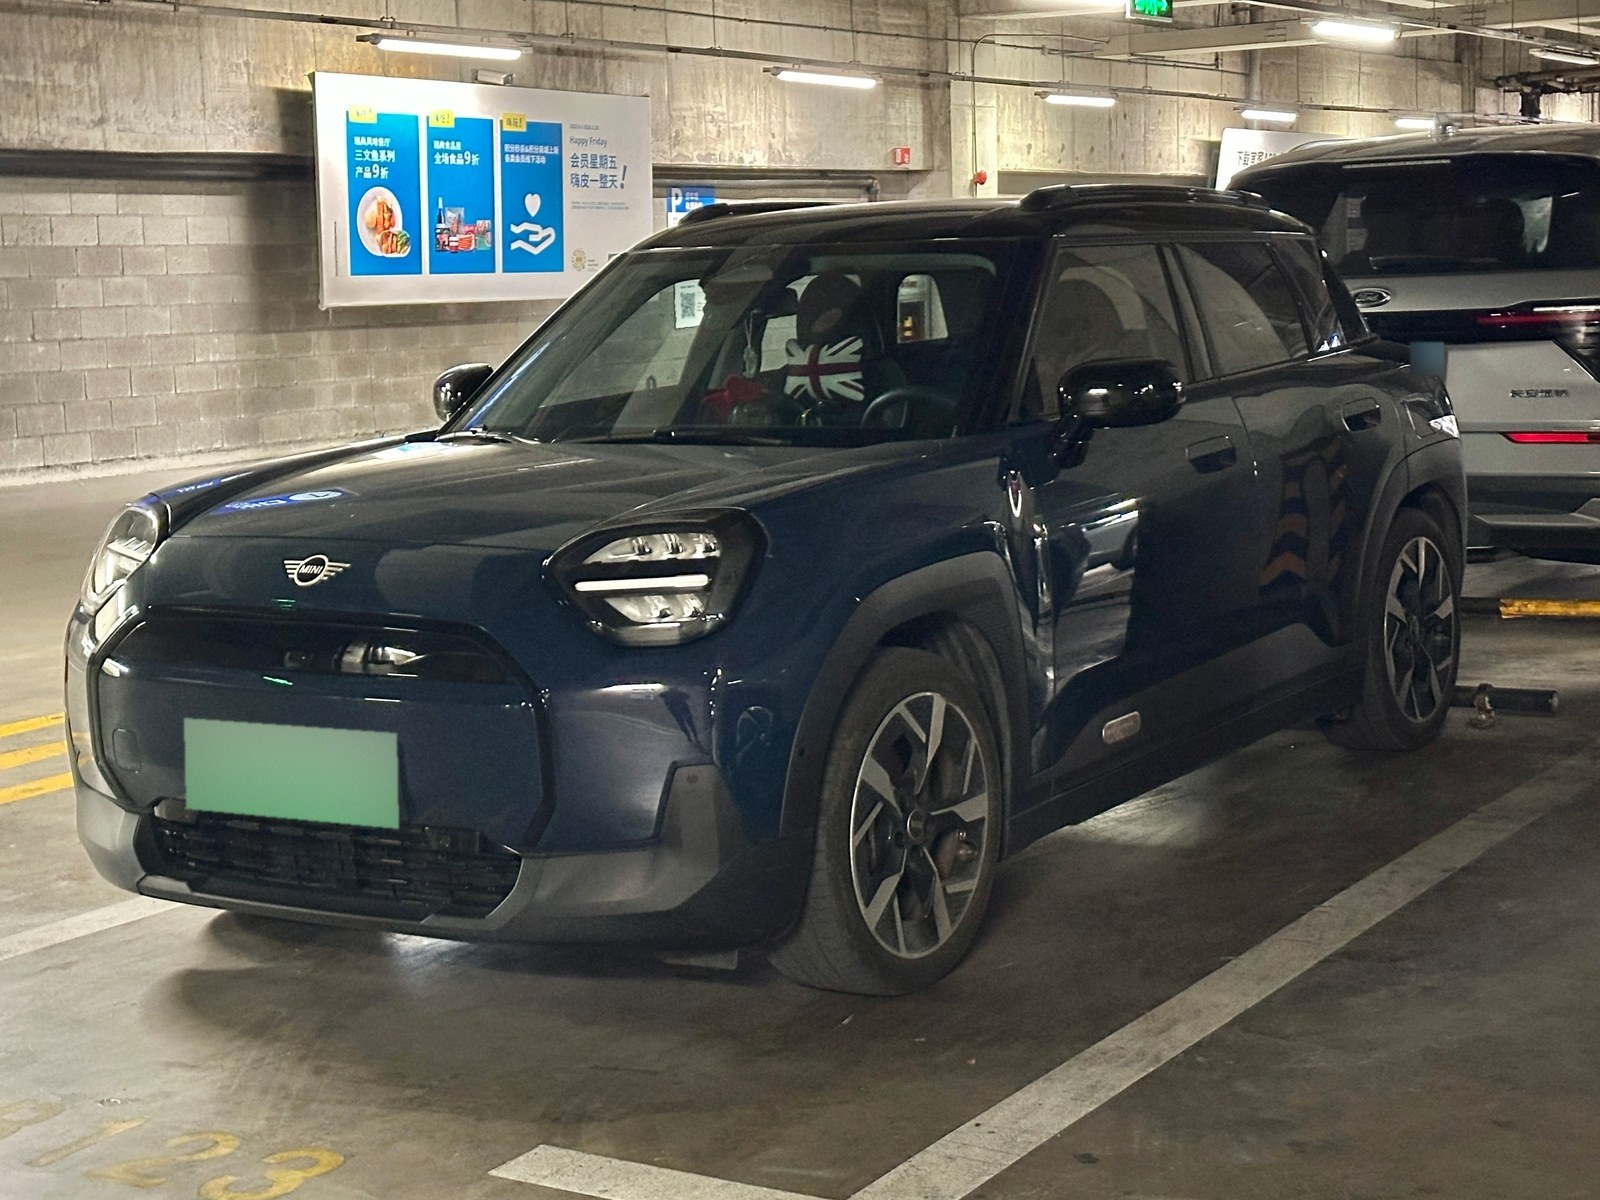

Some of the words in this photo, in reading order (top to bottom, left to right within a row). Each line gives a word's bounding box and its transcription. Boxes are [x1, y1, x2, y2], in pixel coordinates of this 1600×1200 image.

[569, 136, 588, 147] Happy
[589, 137, 608, 148] Friday
[354, 149, 396, 162] 三文鱼系列
[433, 150, 480, 166] 全场食品9折
[570, 152, 618, 170] 会员星期五
[355, 163, 389, 179] 产品9折
[671, 187, 683, 212] P
[298, 564, 324, 575] MINI
